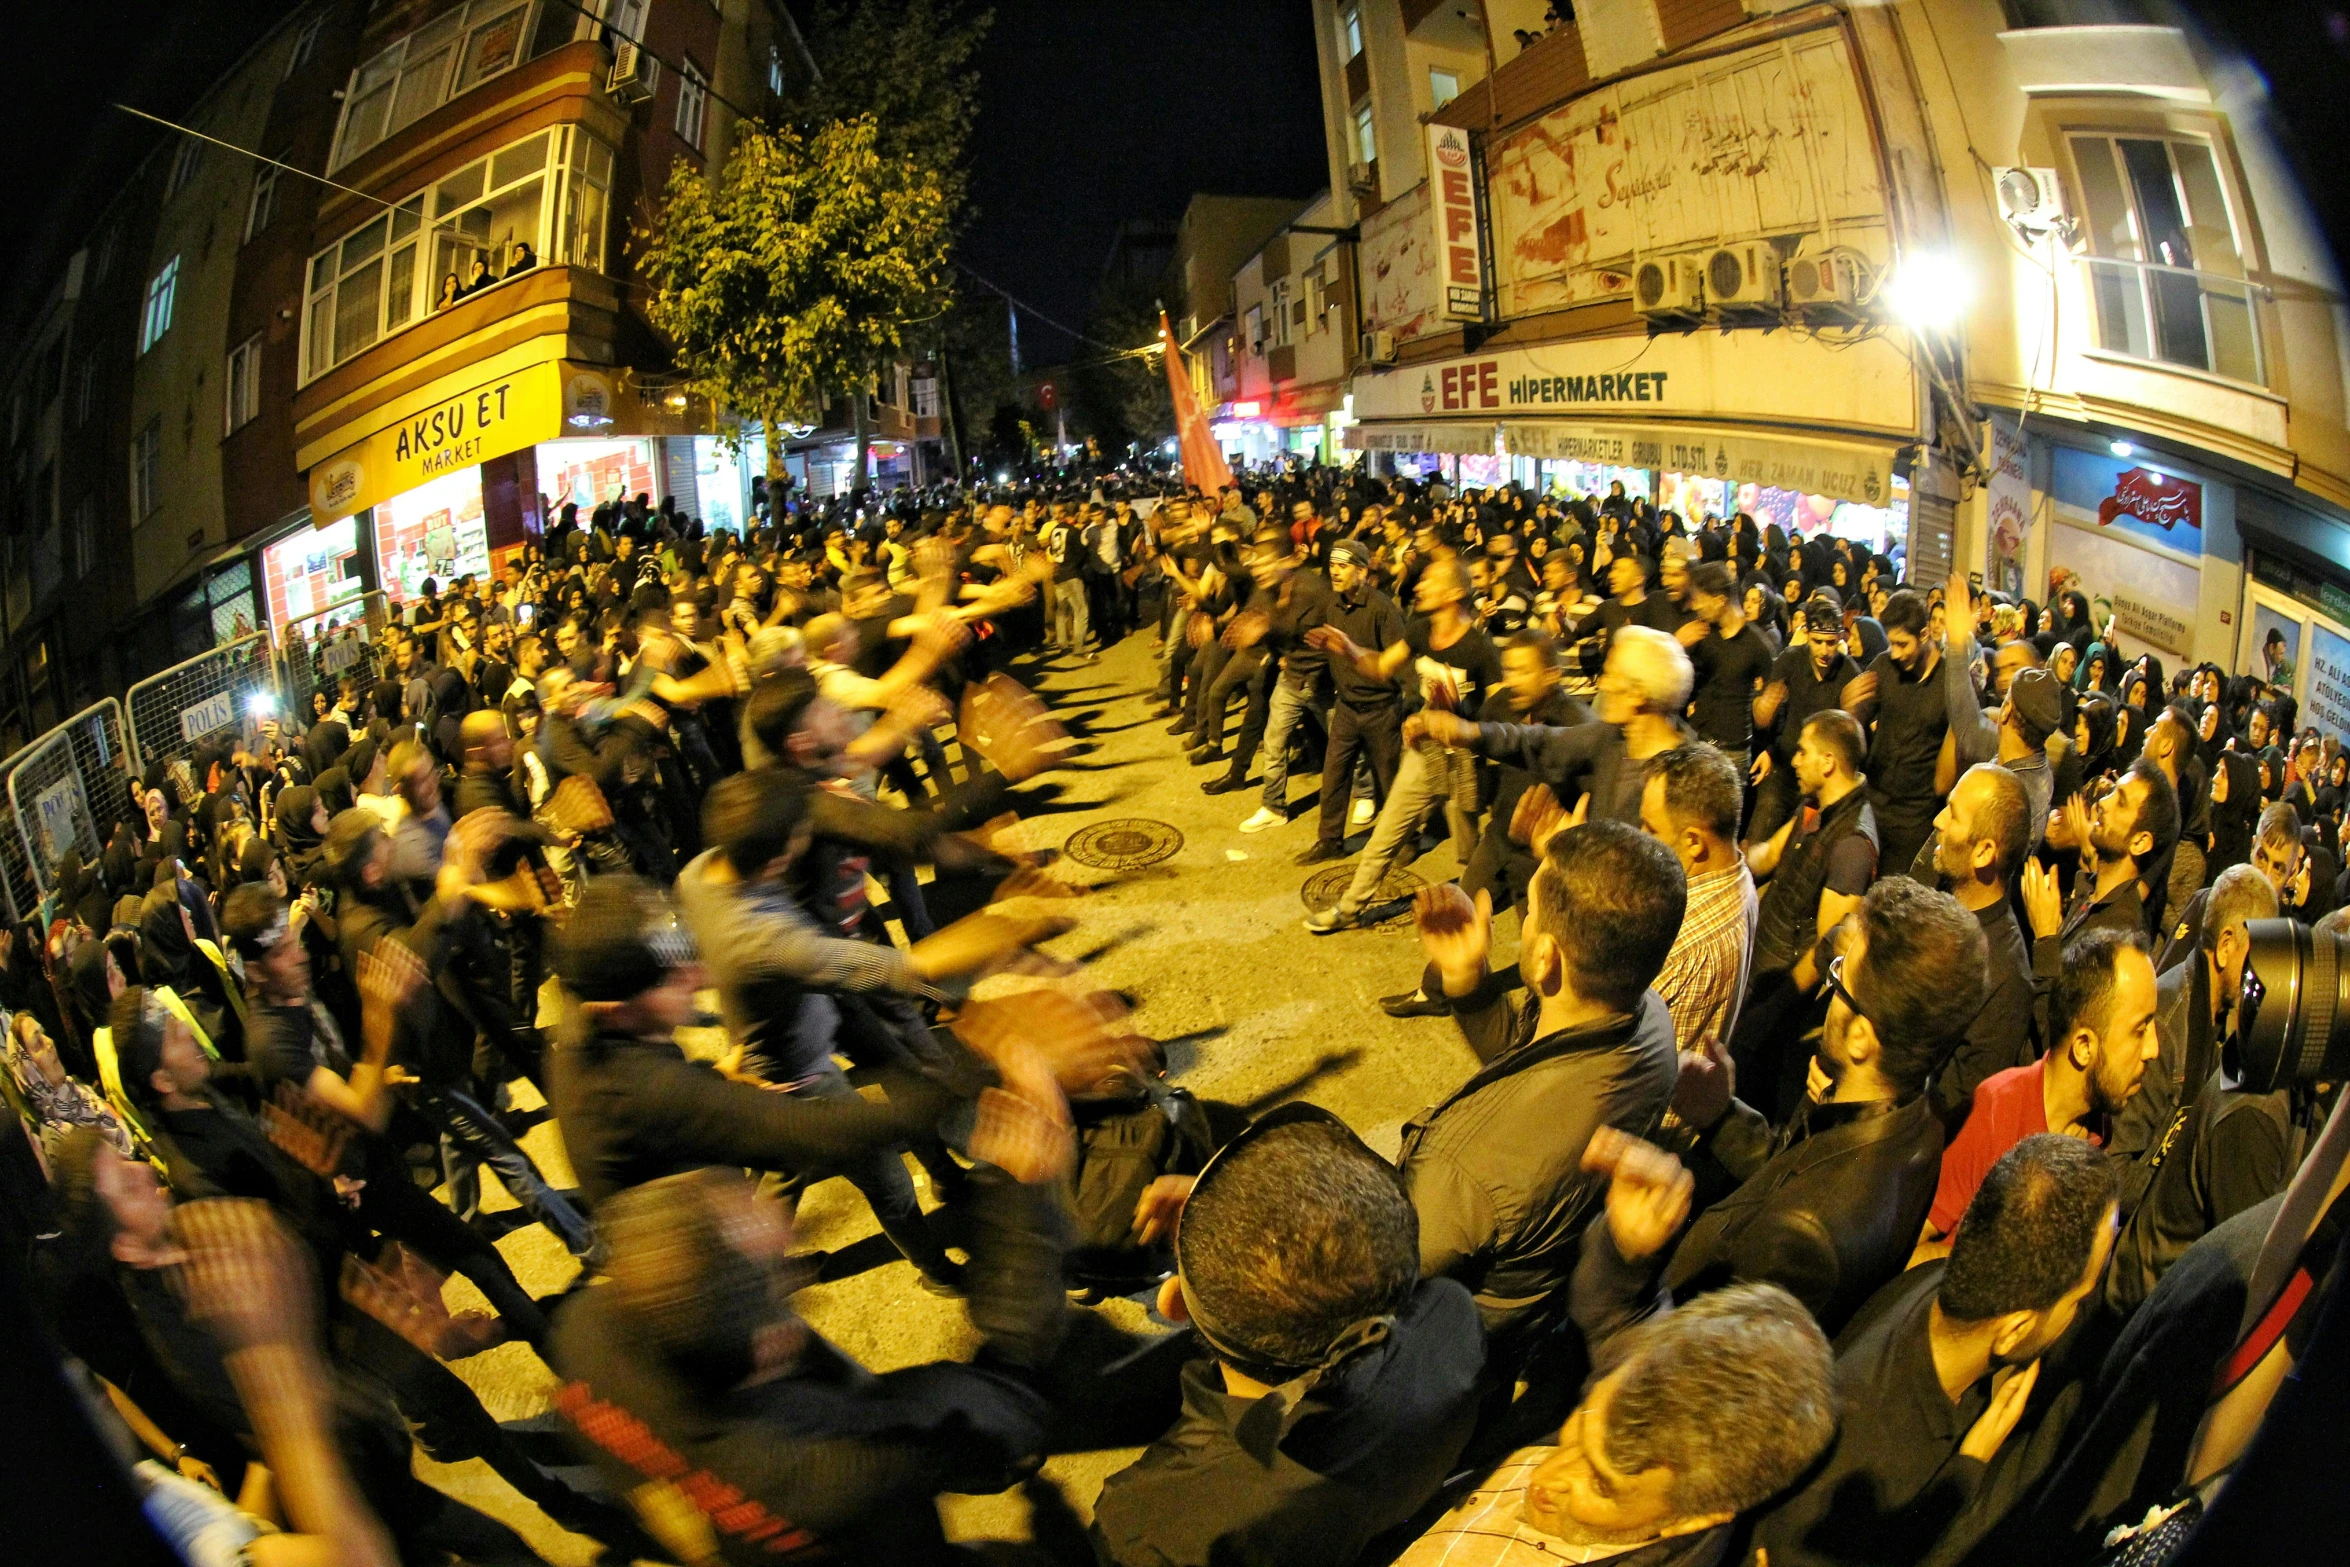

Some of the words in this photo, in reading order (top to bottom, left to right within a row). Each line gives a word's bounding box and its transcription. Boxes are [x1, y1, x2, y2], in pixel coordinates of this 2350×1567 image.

[1442, 170, 1478, 284] EFE
[1442, 361, 1500, 410] EFE
[1509, 371, 1669, 405] HİPERMARKET
[396, 402, 464, 463] AKSU
[477, 383, 511, 429] ET
[422, 436, 483, 477] MARKET
[1632, 440, 1662, 467] GRUBU
[1739, 458, 1763, 481] HER
[1771, 462, 1815, 488] ZAMAN
[1822, 469, 1857, 495] UCUZ
[327, 643, 358, 673] POLİS
[187, 694, 228, 738] POLİS
